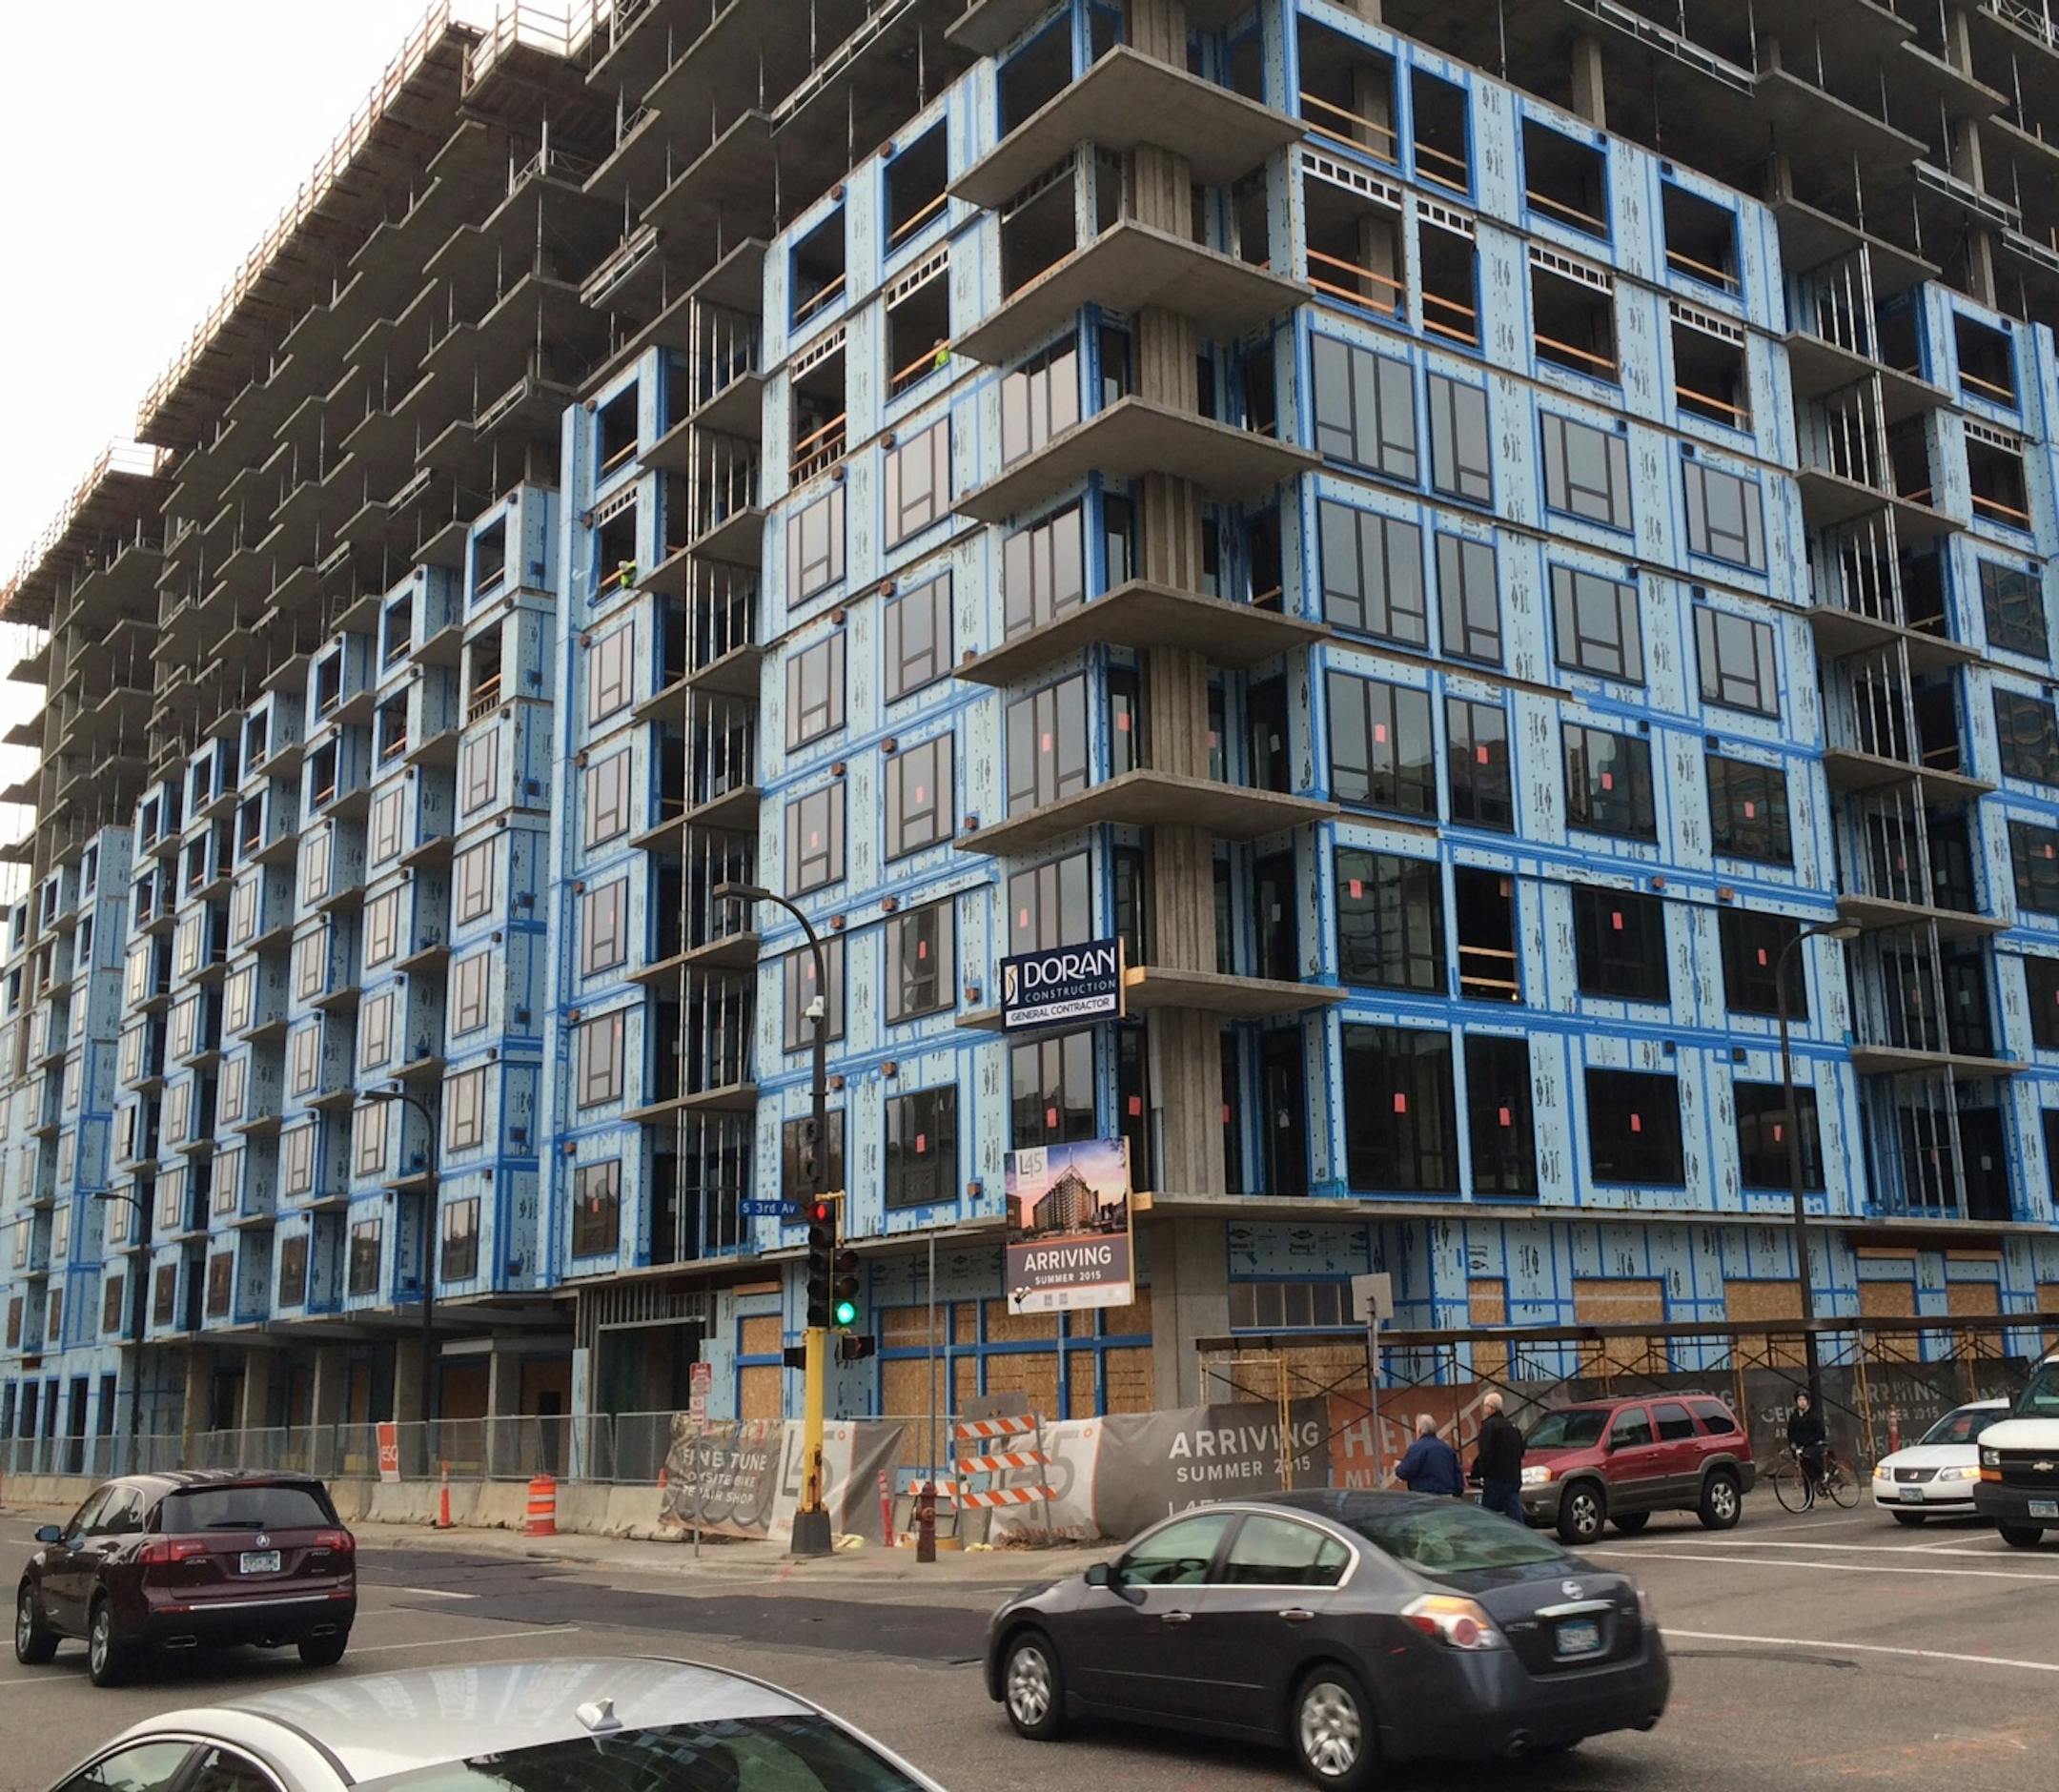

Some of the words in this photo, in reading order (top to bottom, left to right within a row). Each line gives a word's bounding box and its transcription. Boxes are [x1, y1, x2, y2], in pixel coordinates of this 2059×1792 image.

[1024, 947, 1115, 988] DORAN
[1025, 979, 1116, 1003] CONSTRUCTION
[1010, 1007, 1050, 1022] GENERAL
[1050, 997, 1110, 1015] CONTRACTOR
[1019, 1151, 1043, 1177] L45
[743, 1203, 750, 1213] S
[755, 1203, 776, 1213] 3rd
[782, 1203, 796, 1213] Av
[1024, 1245, 1112, 1272] ARRIVING
[1034, 1273, 1074, 1285] SUMMER
[1079, 1271, 1101, 1281] 2015
[1860, 1409, 1909, 1422] SUMER
[1168, 1421, 1319, 1459] ARRIVING
[683, 1449, 724, 1468] FINE
[730, 1453, 767, 1471] TUNE
[1176, 1460, 1263, 1483] SUMMER
[1273, 1456, 1311, 1474] 215
[725, 1492, 755, 1504] SHOP
